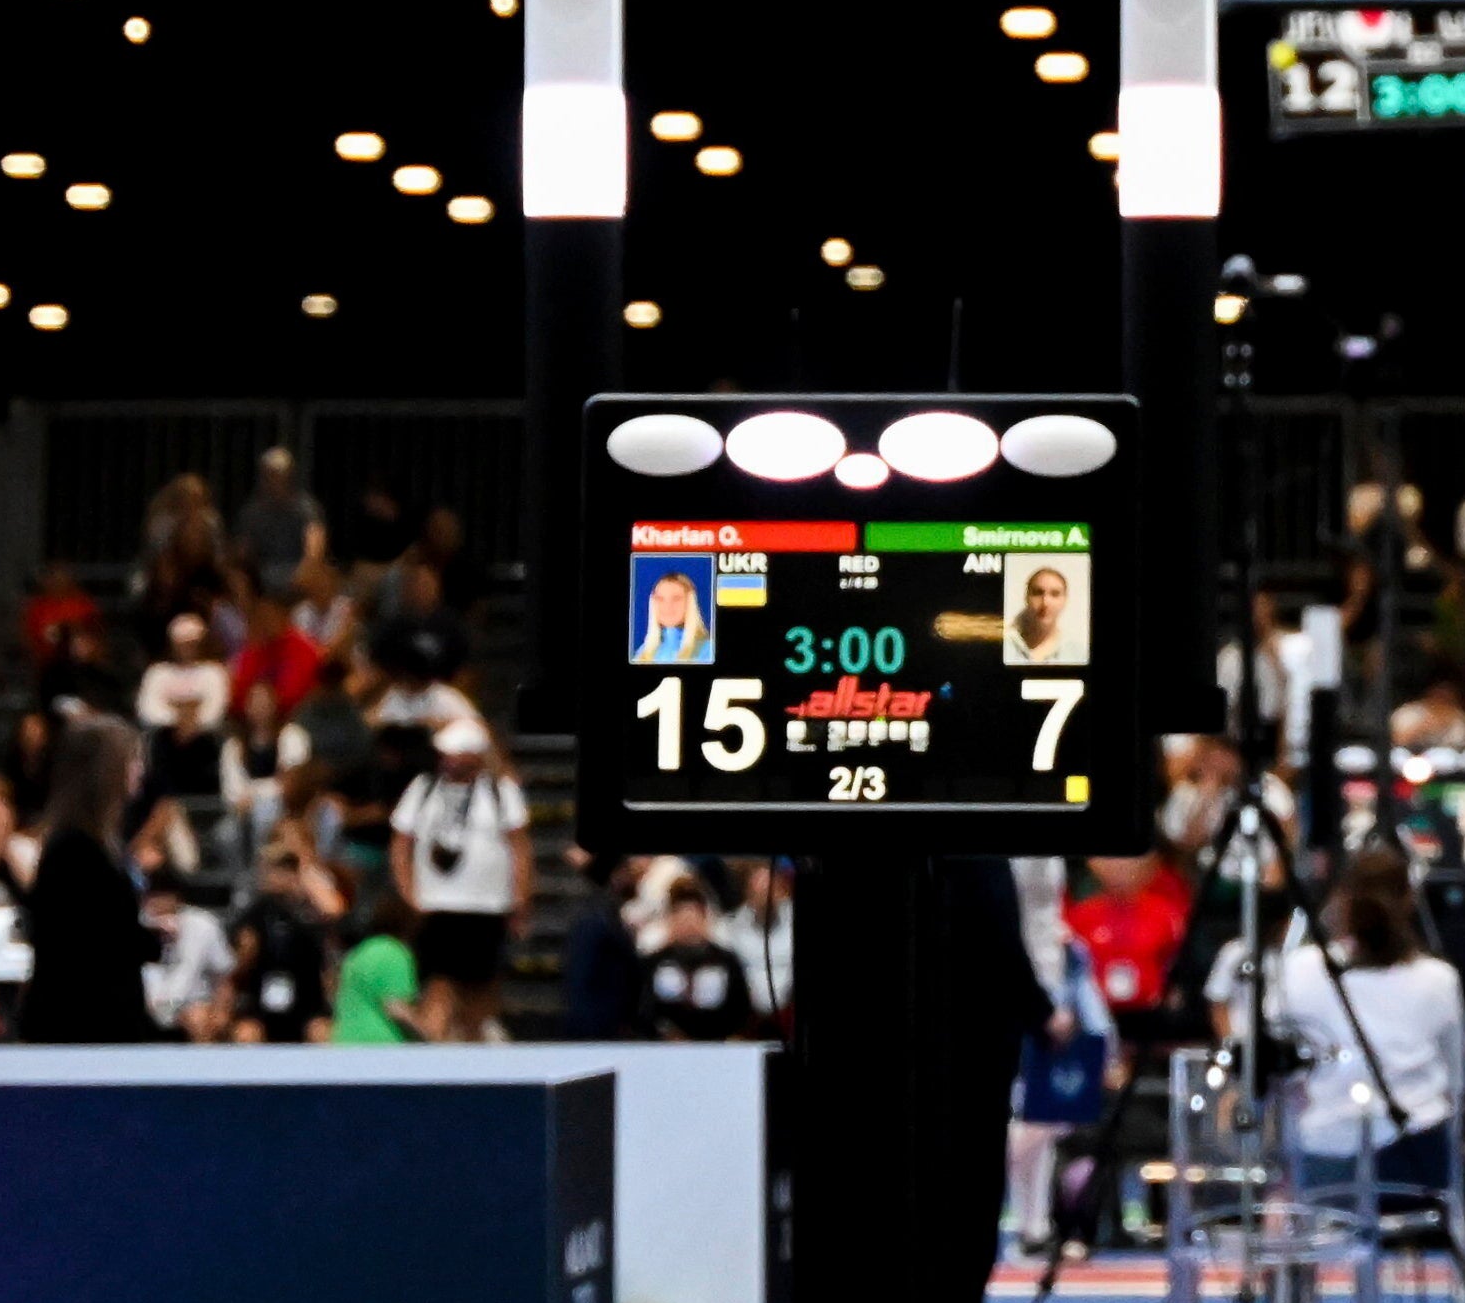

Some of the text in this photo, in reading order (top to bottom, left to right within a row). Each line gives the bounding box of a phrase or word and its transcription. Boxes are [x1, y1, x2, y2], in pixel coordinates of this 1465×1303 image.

[1284, 60, 1358, 112] 12
[963, 525, 1090, 547] Smirnova A.
[718, 553, 768, 573] UKR
[838, 555, 880, 573] RED
[963, 553, 1002, 574] AIN
[784, 625, 906, 674] 3:00
[803, 674, 932, 719] allstar
[637, 677, 767, 772] 15
[1020, 678, 1085, 772] 7
[827, 766, 887, 801] 2/3
